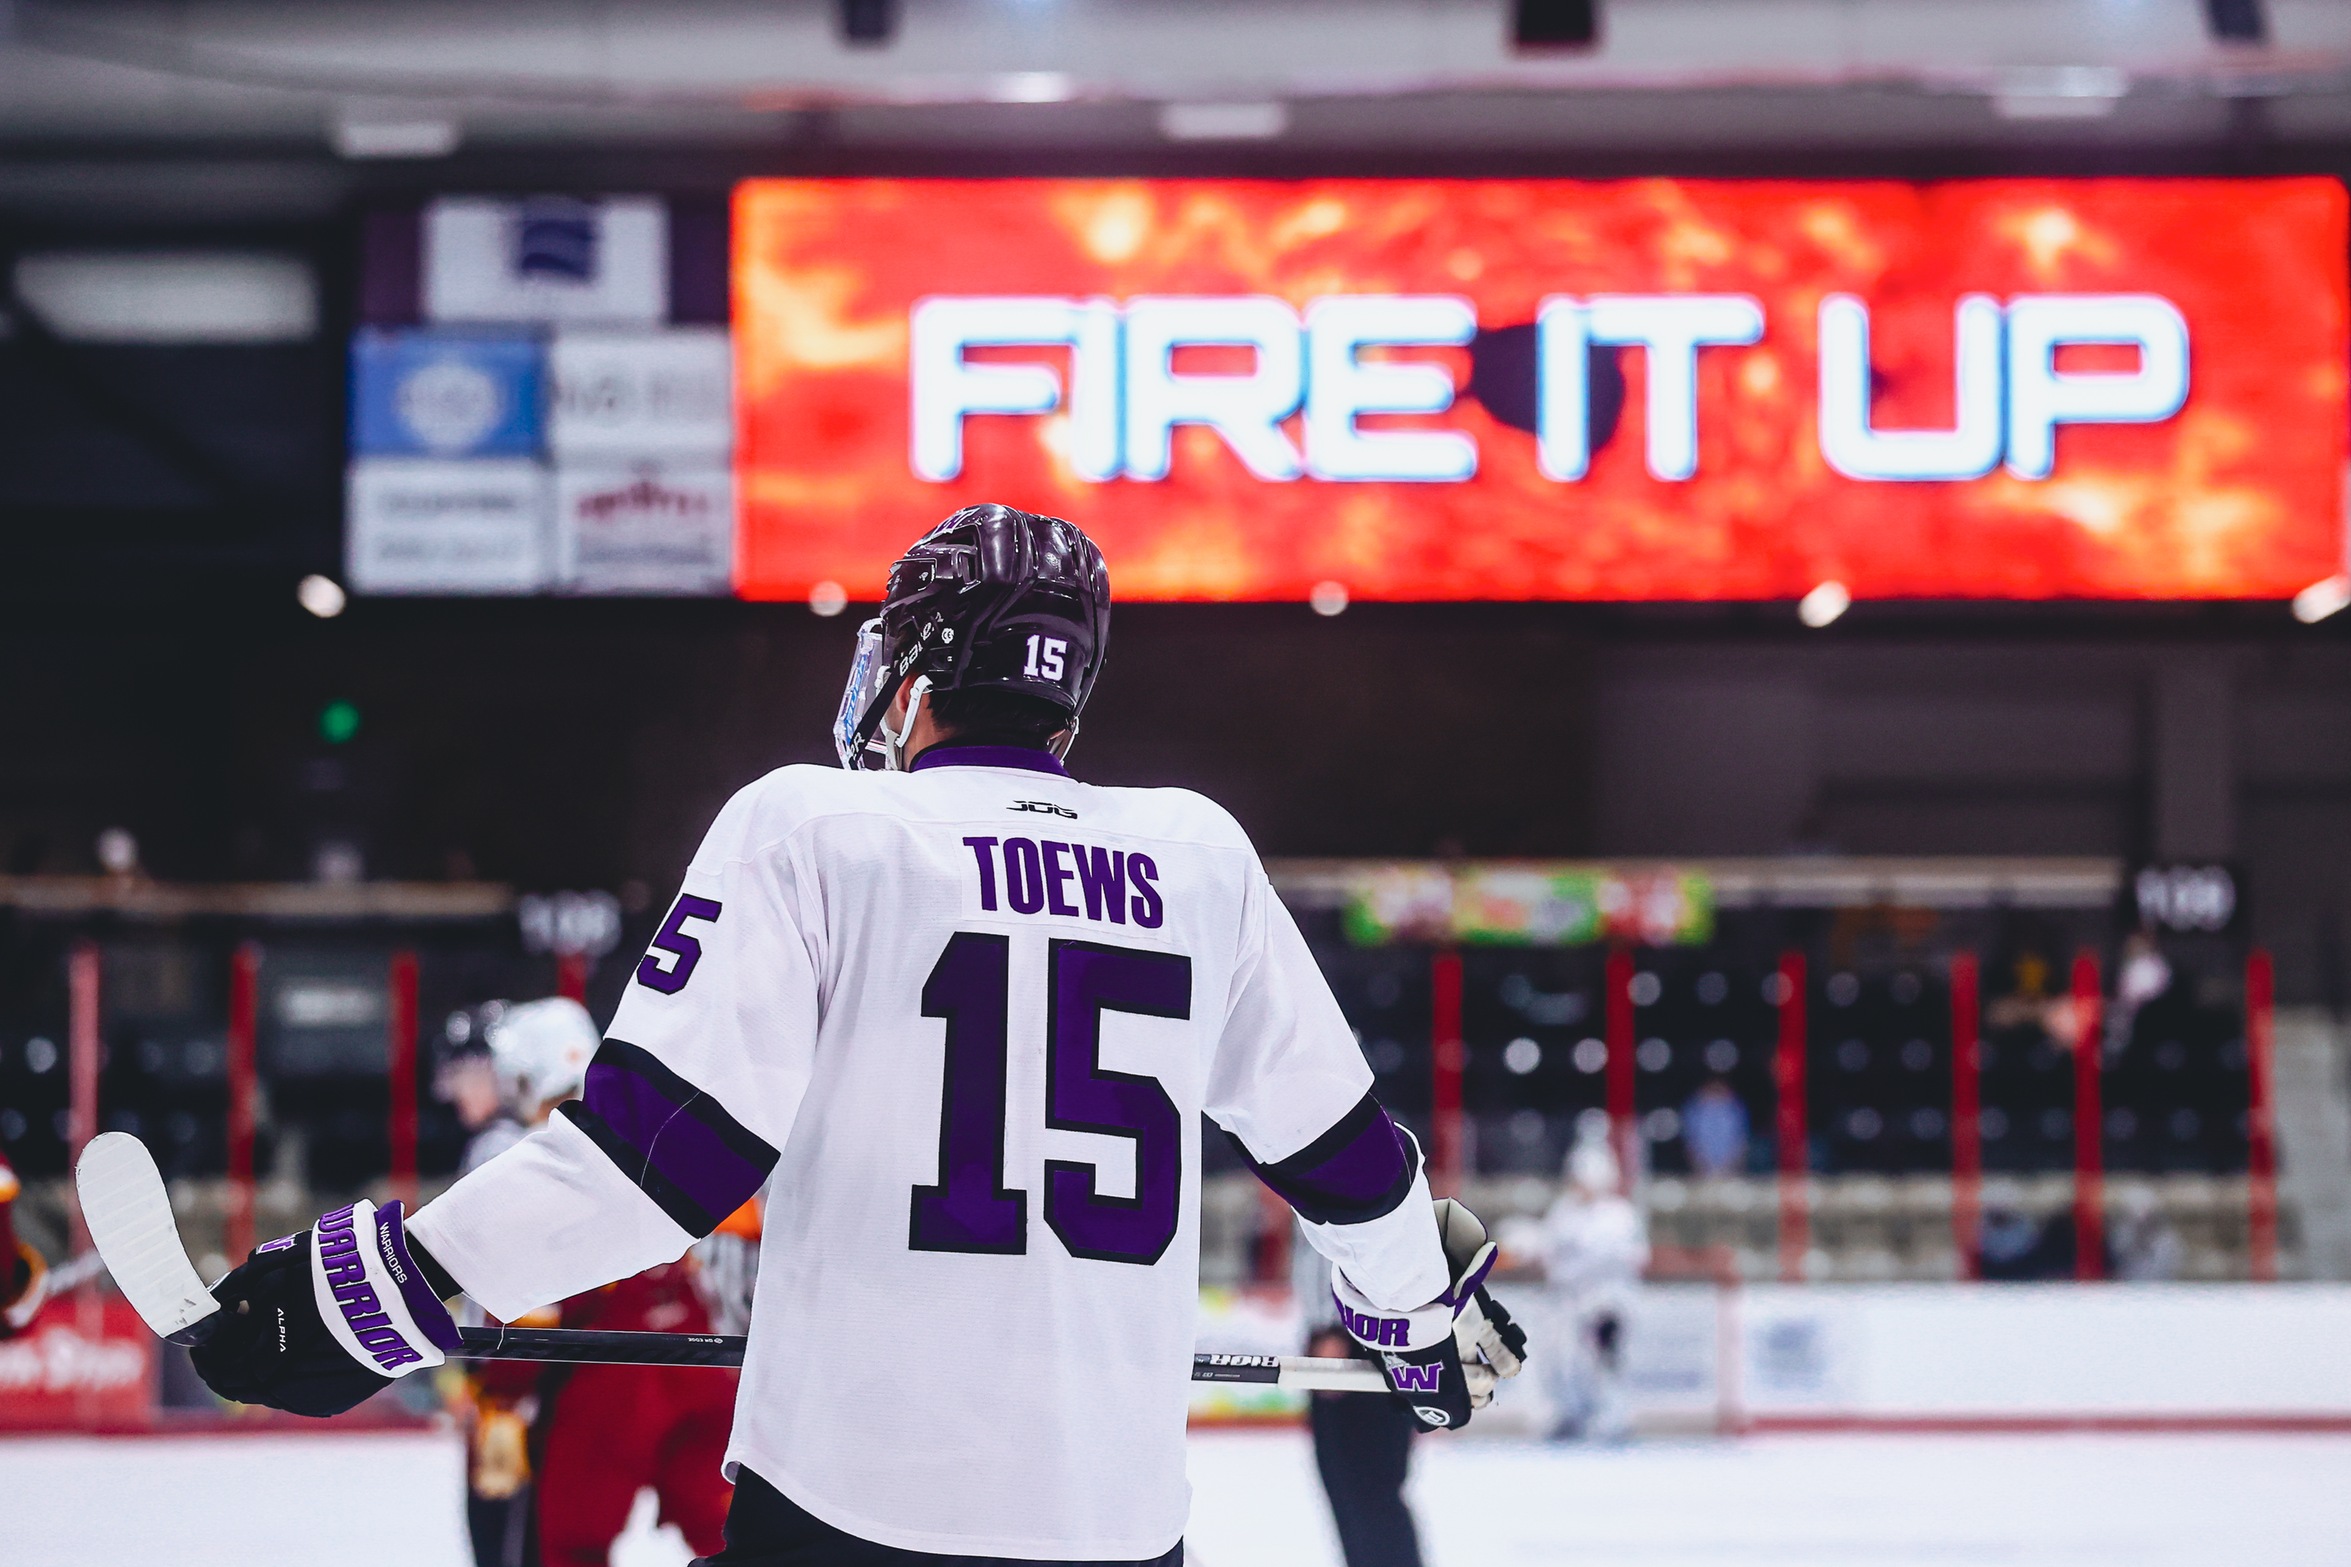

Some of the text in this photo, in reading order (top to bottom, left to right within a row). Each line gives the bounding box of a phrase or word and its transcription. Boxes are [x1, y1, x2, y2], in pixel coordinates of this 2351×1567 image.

[909, 292, 2192, 484] FIRE IT UP
[1023, 633, 1068, 683] 15
[962, 836, 1163, 929] TOEWS
[908, 931, 1192, 1266] 15
[317, 1203, 424, 1372] WARRIOR
[378, 1221, 408, 1285] WARRIORS
[276, 1306, 288, 1353] ALPHA
